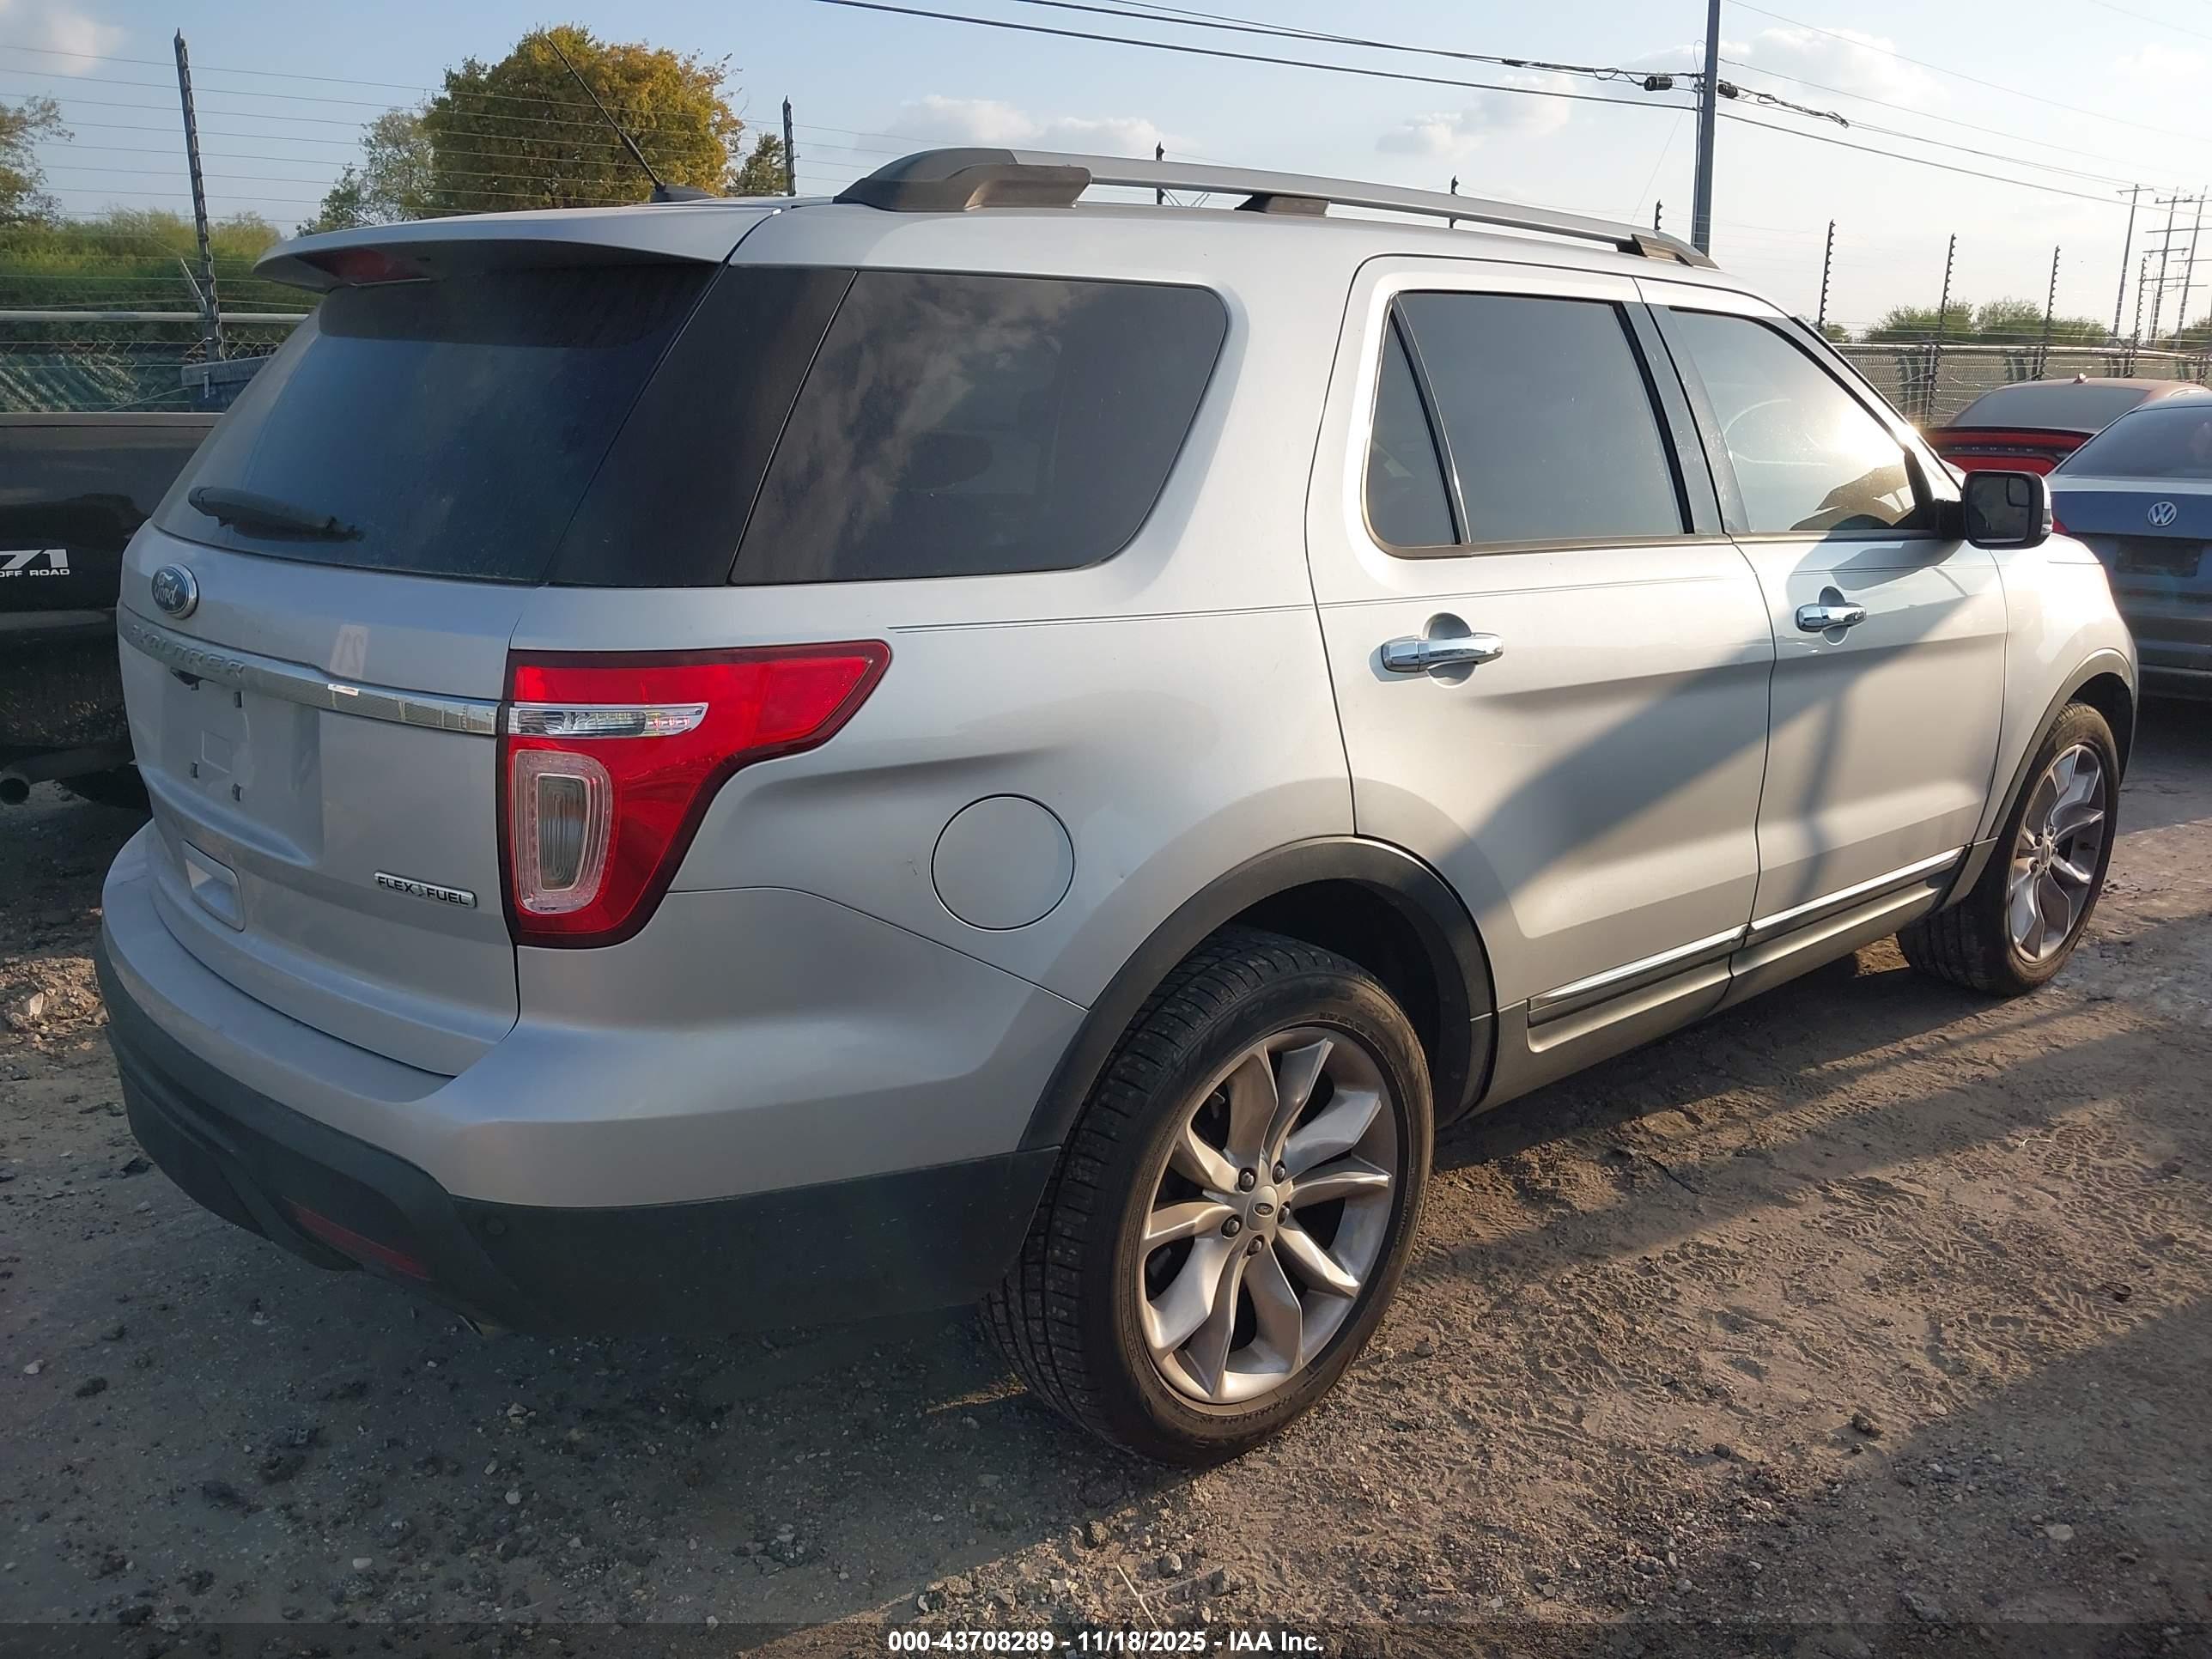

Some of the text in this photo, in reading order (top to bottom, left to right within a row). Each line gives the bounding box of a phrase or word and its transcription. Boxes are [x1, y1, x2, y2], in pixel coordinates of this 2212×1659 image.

[28, 568, 70, 577] ROAD
[155, 571, 179, 605] Ford
[377, 875, 470, 907] FLEX FUEL
